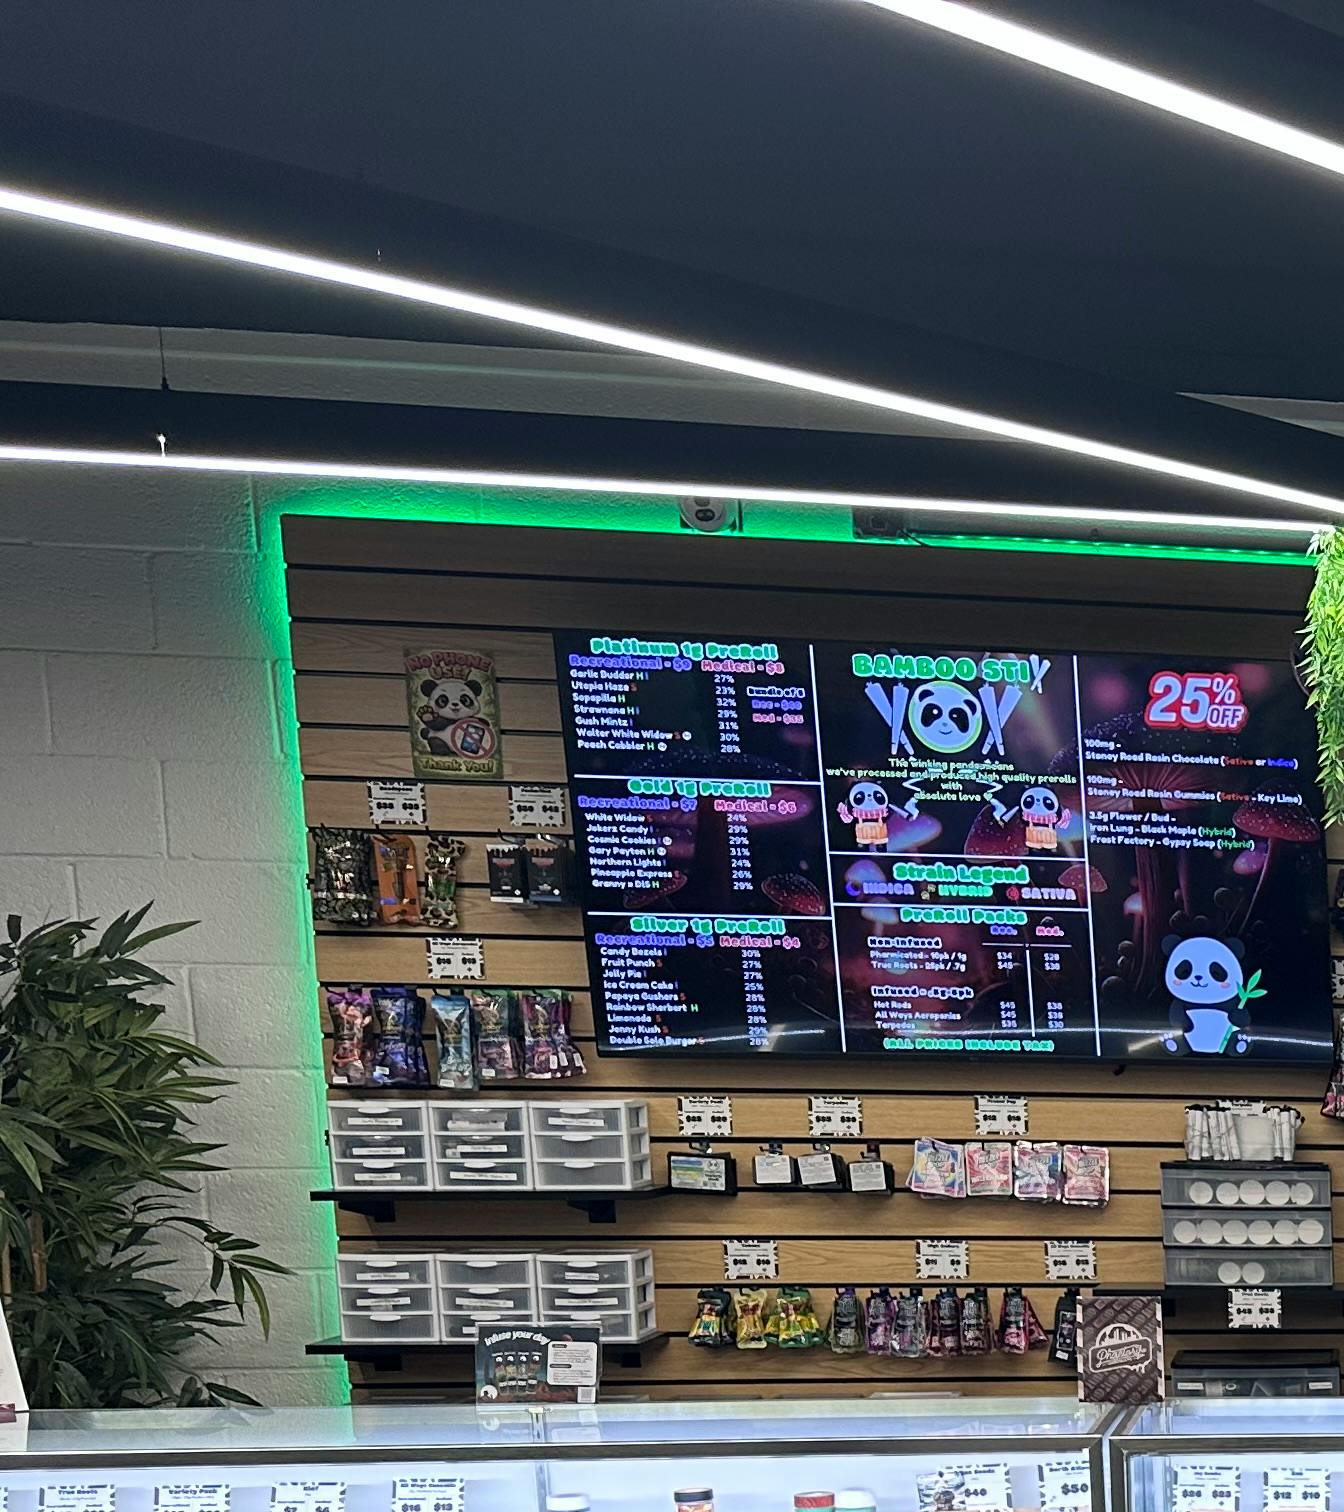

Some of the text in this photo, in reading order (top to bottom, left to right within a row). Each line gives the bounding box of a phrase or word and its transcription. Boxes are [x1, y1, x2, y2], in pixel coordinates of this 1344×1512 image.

[590, 637, 778, 661] Platinum PreRoll
[430, 651, 494, 673] PHONE
[569, 654, 692, 672] Recreational $9
[701, 659, 755, 673] Medical
[852, 653, 977, 681] BAMBOO
[431, 664, 473, 681] USE!
[1207, 705, 1244, 728] OFF
[612, 729, 640, 739] White
[641, 730, 673, 740] Widow
[464, 757, 495, 774] You!
[627, 778, 772, 797] Gold PreRoll
[714, 799, 769, 813] Medical
[1257, 793, 1275, 804] Key
[893, 863, 1029, 885] Strain Legend
[863, 883, 914, 895] INDICA
[1021, 887, 1076, 900] SATIVA
[630, 916, 786, 934] Silver PreRoll
[900, 908, 1028, 925] PreRoll Packs
[719, 936, 772, 948] Medical
[602, 958, 655, 968] Fruit Punch
[484, 1331, 512, 1346] Infuse
[512, 1330, 534, 1340] your
[1302, 1490, 1320, 1500] $10
